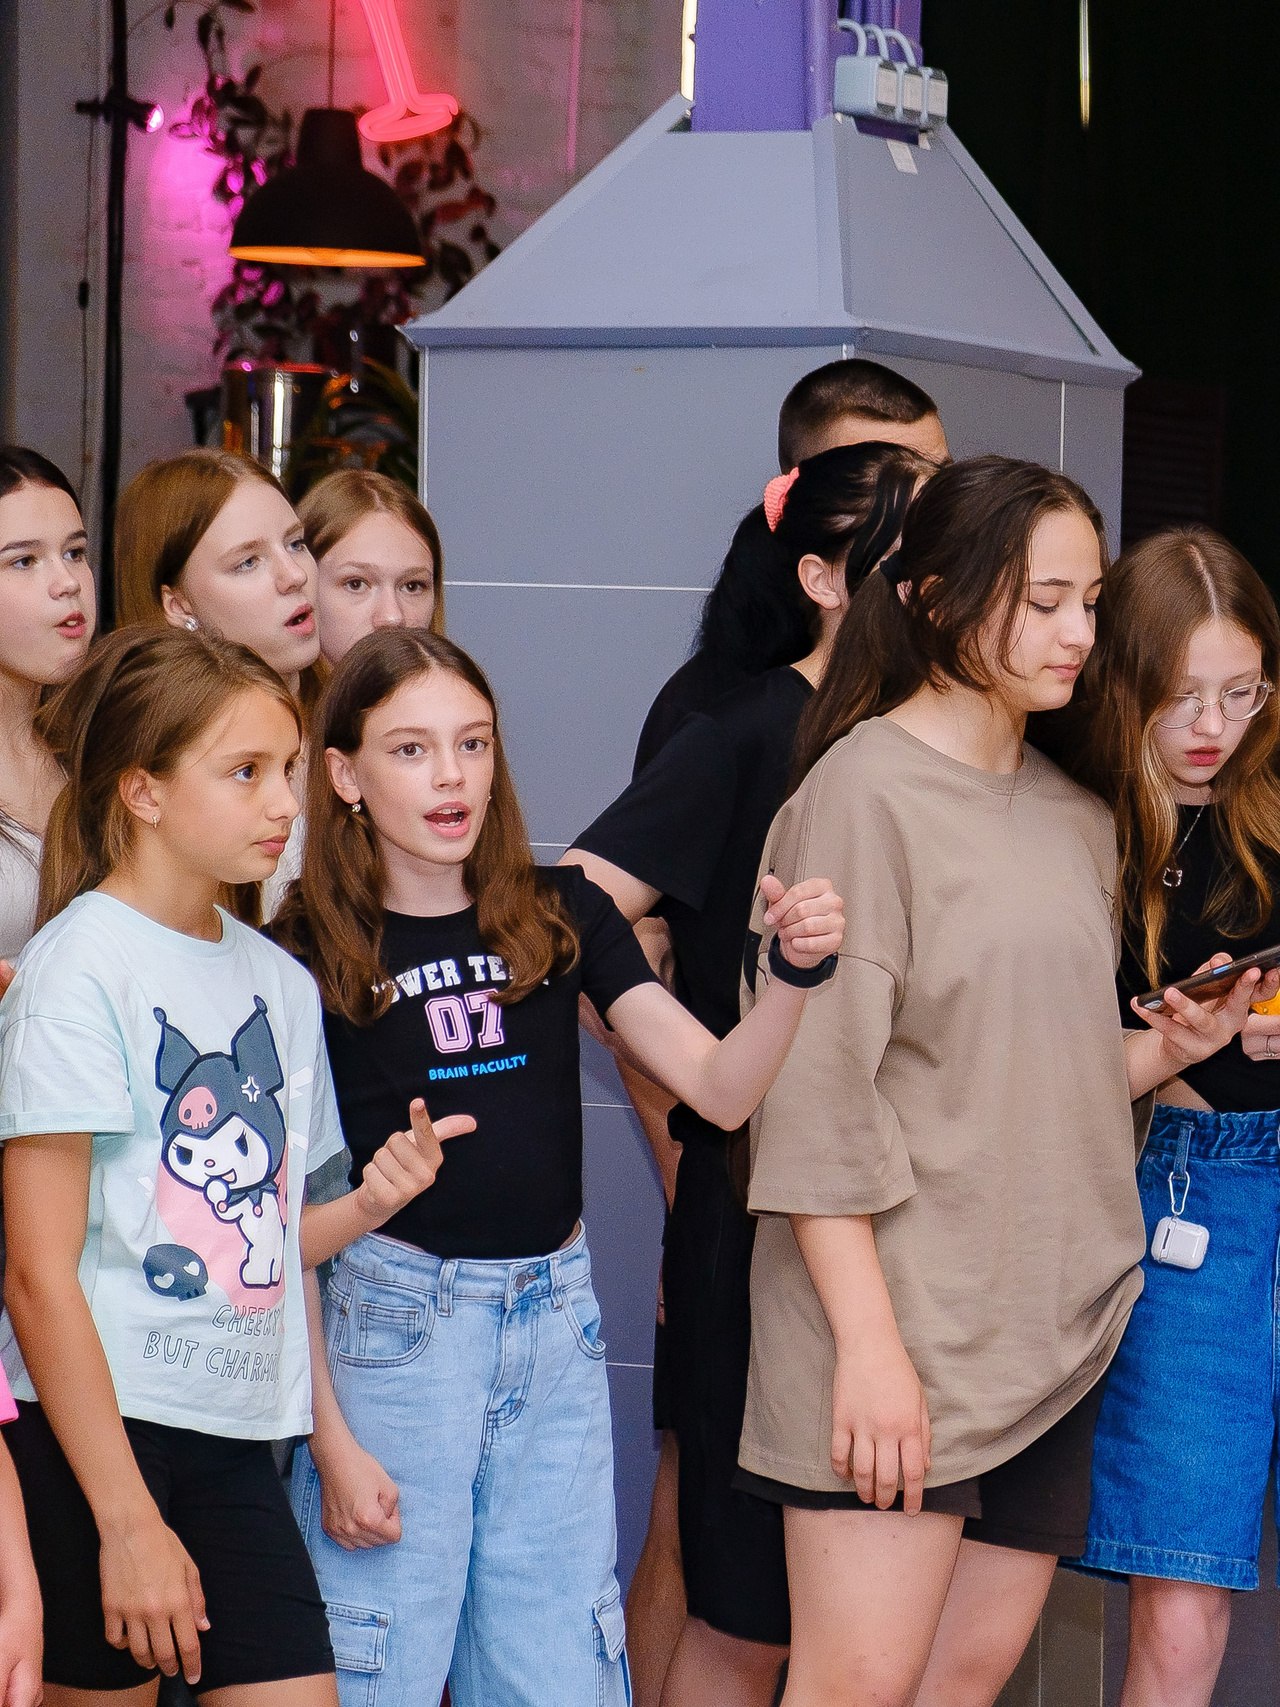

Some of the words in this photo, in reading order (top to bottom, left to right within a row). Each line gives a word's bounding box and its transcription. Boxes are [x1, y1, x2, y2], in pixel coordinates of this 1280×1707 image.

[425, 988, 504, 1054] 07
[428, 1065, 469, 1081] BRAIN
[471, 1054, 527, 1076] FACULTY
[211, 1304, 280, 1337] CHEEKY
[143, 1331, 199, 1369] BUT
